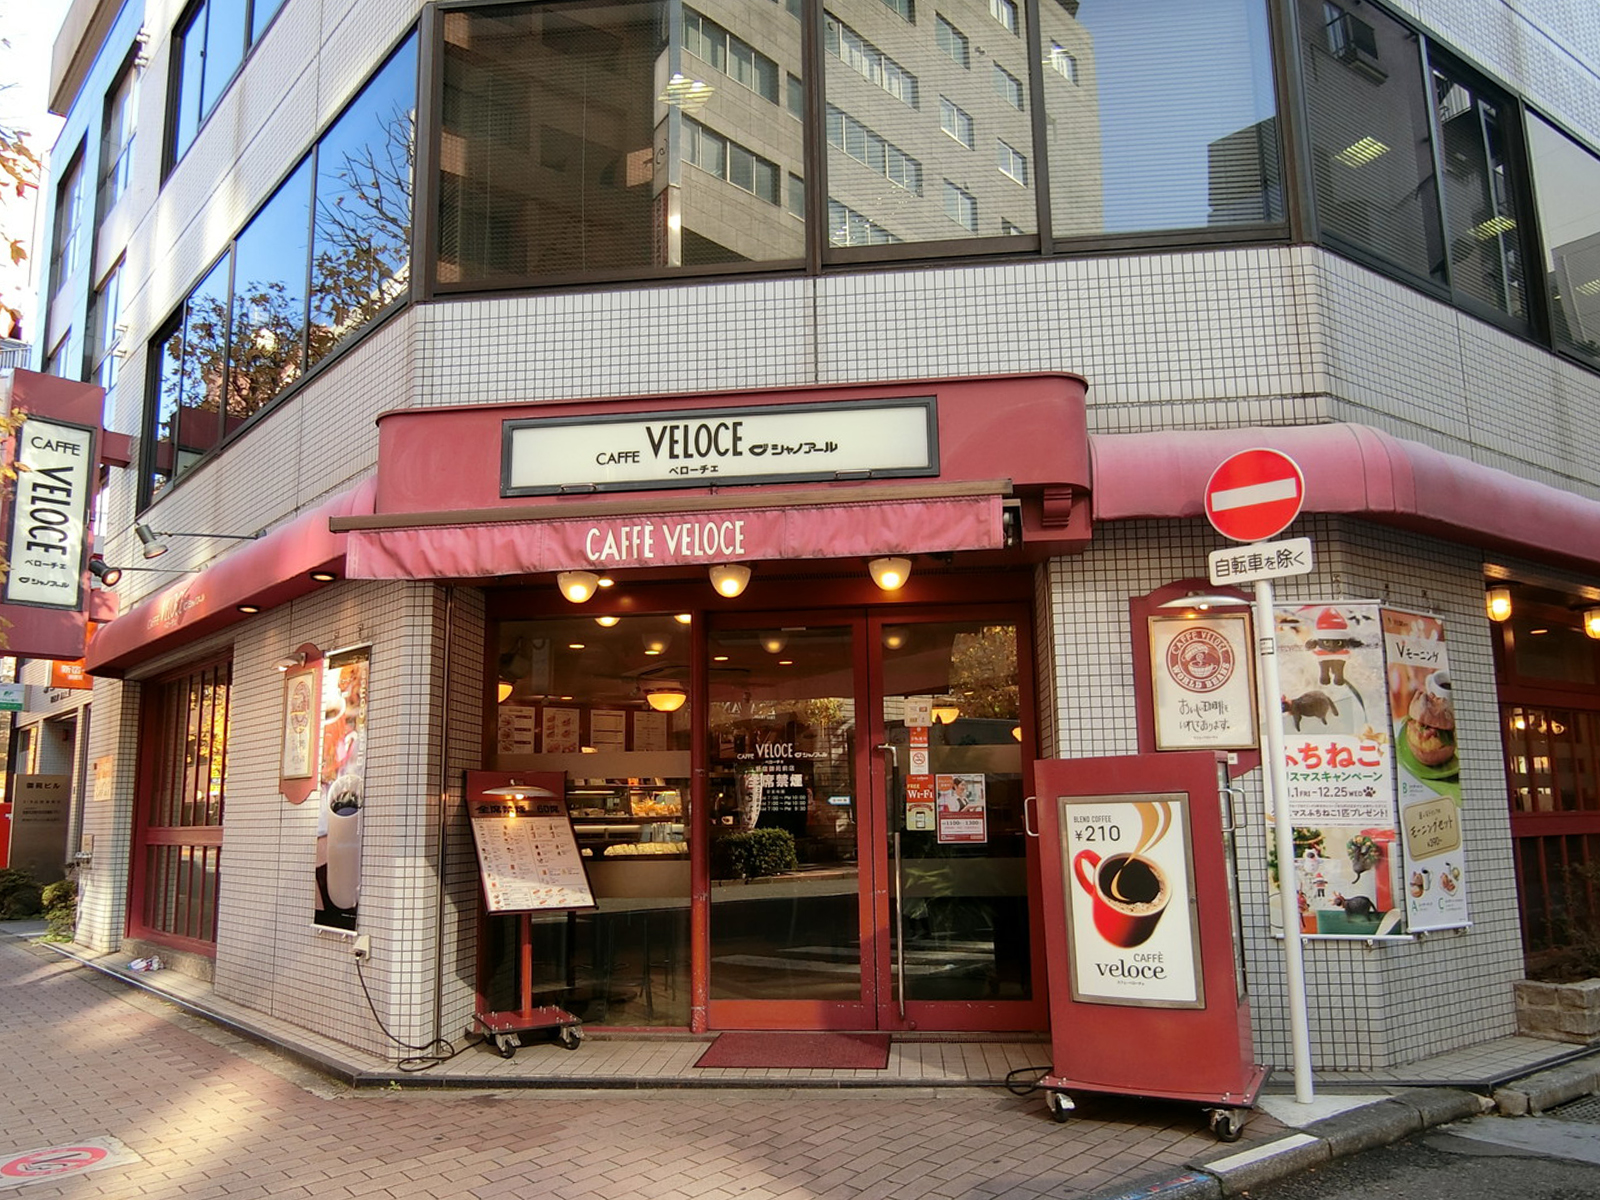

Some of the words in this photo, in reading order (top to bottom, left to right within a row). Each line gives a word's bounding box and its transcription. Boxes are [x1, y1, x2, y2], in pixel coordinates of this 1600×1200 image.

[31, 436, 81, 456] CAFFE
[596, 450, 640, 466] CAFFE
[645, 421, 743, 460] VELOCE
[771, 441, 838, 456] シャノアール
[26, 466, 74, 556] VELOCE
[586, 521, 654, 561] CAFFÈ
[662, 520, 745, 556] VELOCE
[1215, 548, 1305, 578] 自転車を除く
[755, 743, 793, 758] VELOCE
[907, 789, 934, 799] Wi-Fi
[1074, 815, 1090, 823] BLEND
[1091, 815, 1112, 823] COFFEE
[1290, 808, 1389, 818] マスふちねこ1匹プレゼント!
[1075, 825, 1121, 842] ¥210
[1133, 951, 1164, 963] CAFFÈ
[1095, 958, 1168, 980] veloce
